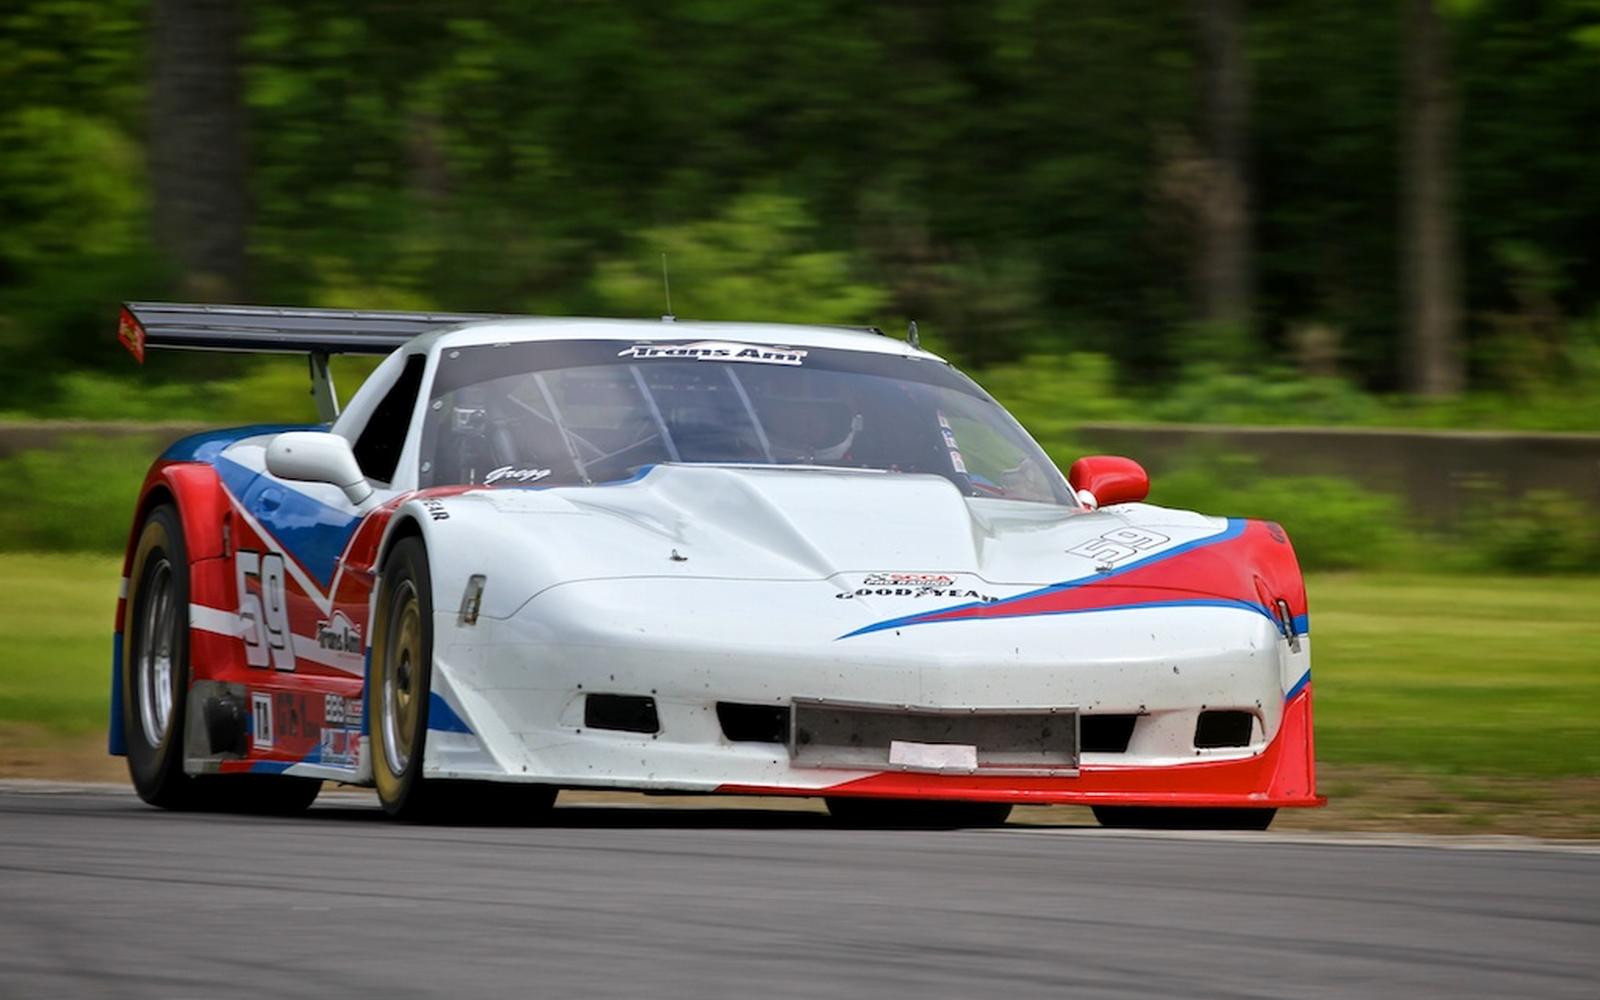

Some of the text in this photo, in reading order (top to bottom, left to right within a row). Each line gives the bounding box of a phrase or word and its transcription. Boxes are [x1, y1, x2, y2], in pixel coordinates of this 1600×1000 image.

[628, 345, 802, 362] Trans Am
[483, 465, 551, 485] Gregg
[1065, 526, 1171, 564] 59
[236, 549, 296, 672] 59
[316, 621, 342, 651] Trans
